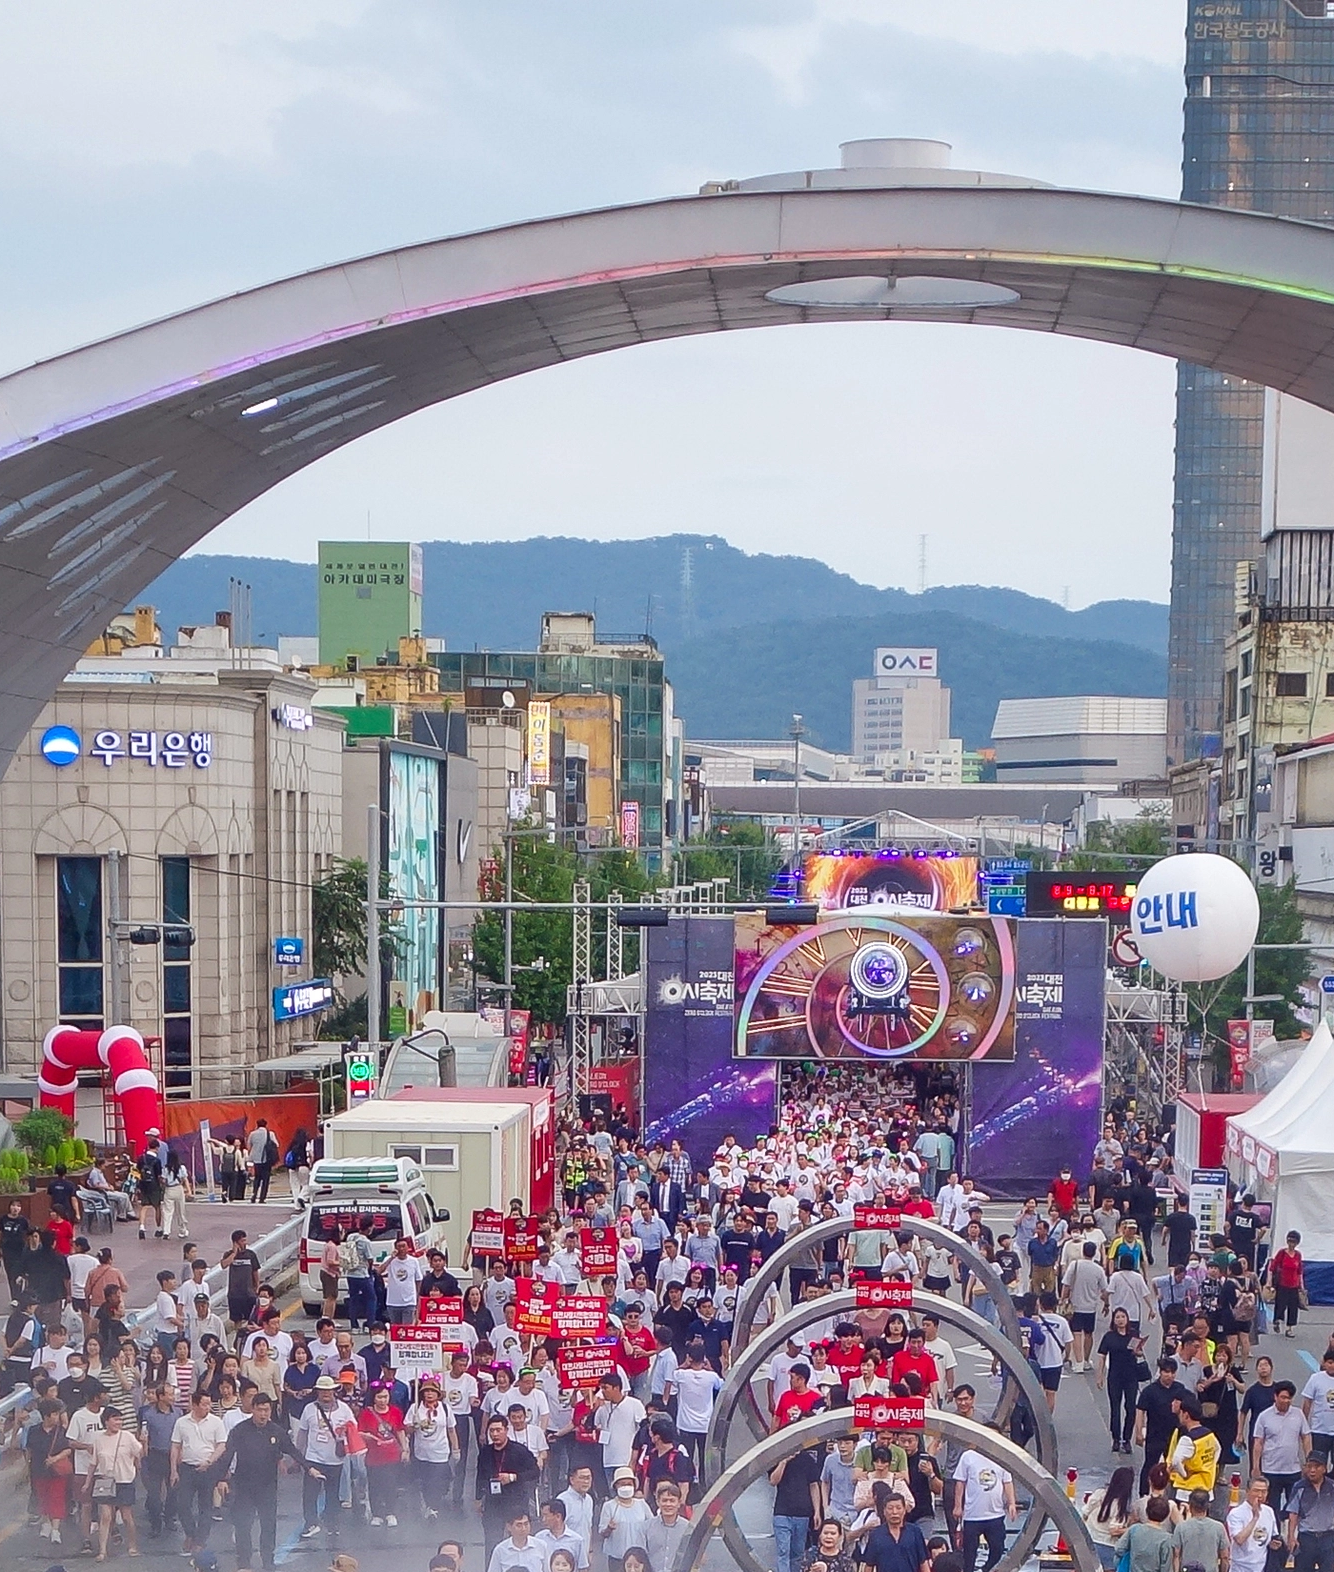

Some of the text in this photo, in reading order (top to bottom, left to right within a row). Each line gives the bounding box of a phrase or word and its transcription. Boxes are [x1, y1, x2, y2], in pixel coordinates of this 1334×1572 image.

[1194, 21, 1287, 40] 한국철도공사
[323, 574, 405, 585] 아카데미극장
[91, 730, 213, 768] 우리은행
[1136, 890, 1198, 935] 안내
[86, 1422, 107, 1432] FIL
